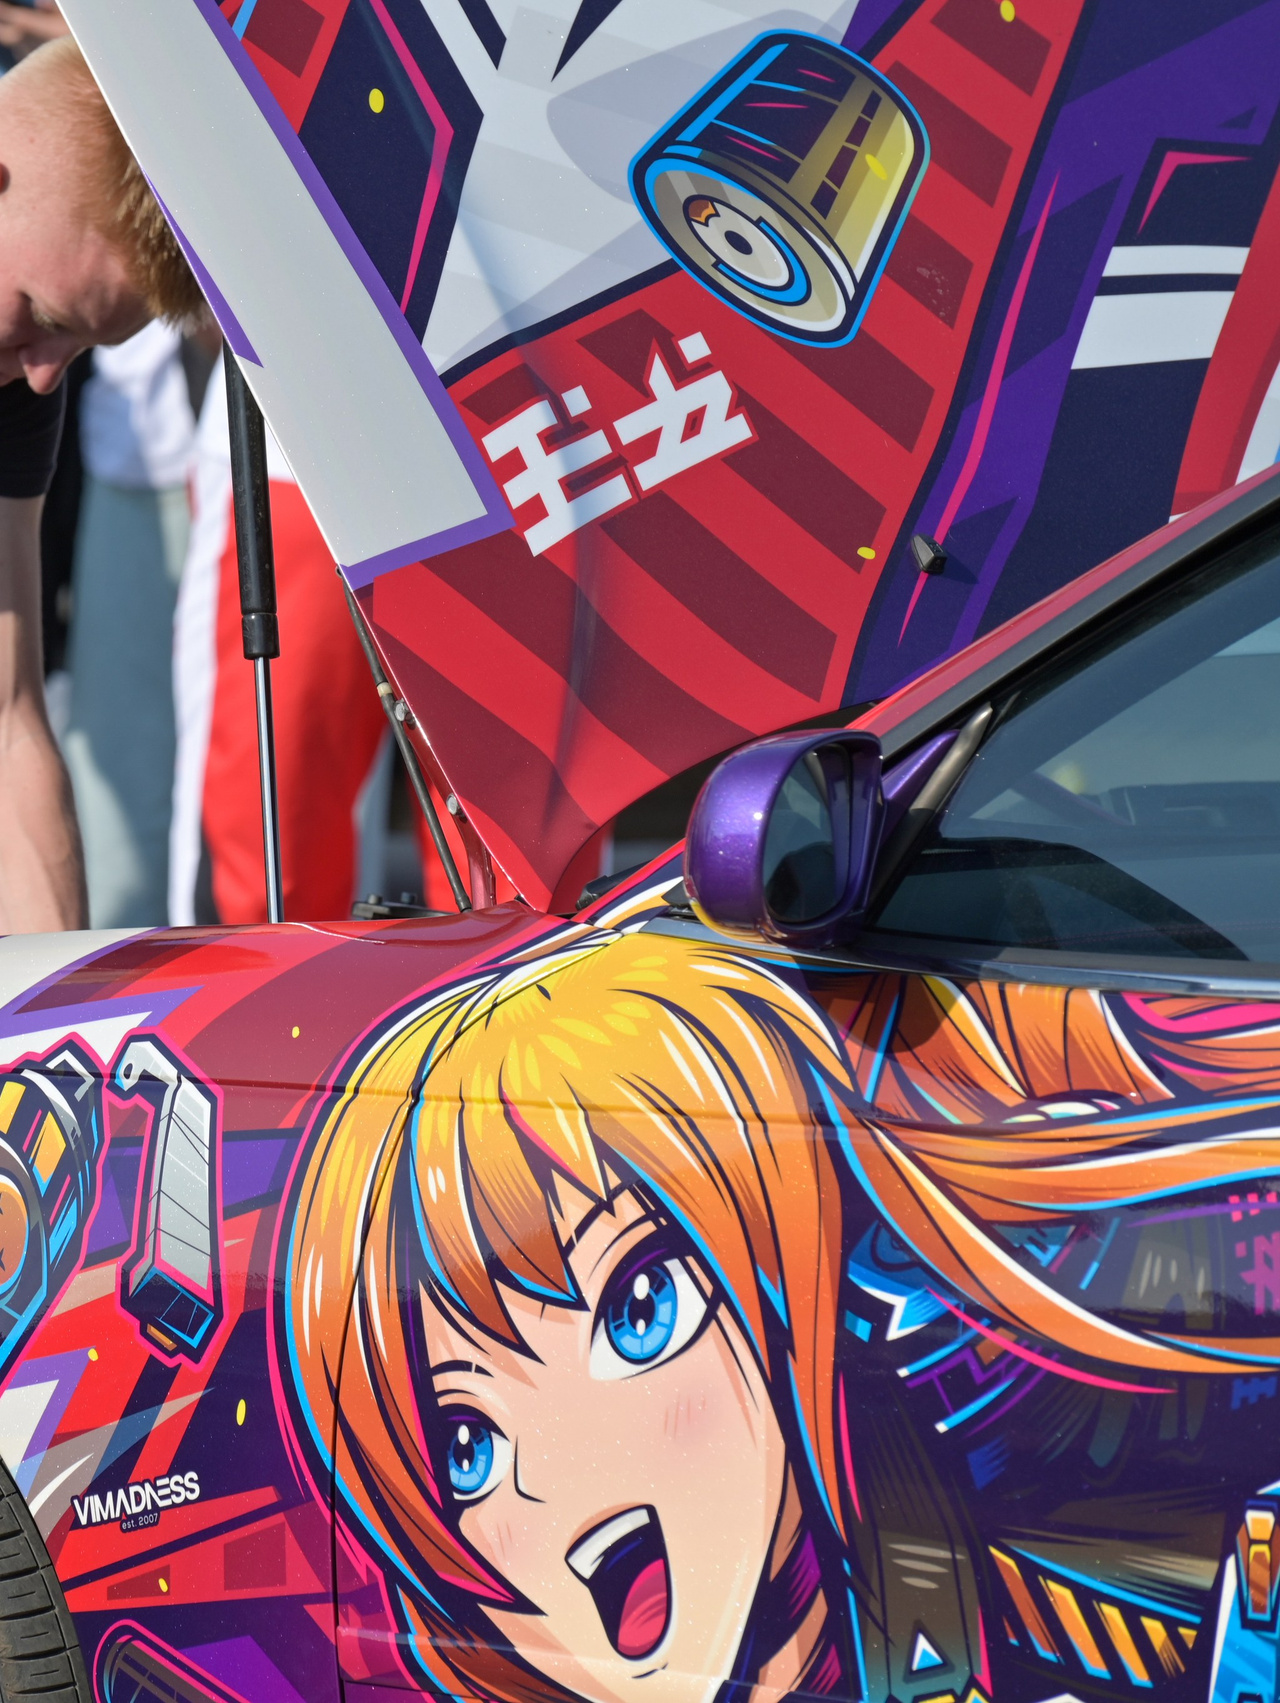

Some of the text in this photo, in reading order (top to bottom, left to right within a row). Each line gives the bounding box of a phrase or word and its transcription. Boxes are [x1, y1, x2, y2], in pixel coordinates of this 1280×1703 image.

[73, 1471, 200, 1526] VIMADNESS
[122, 1513, 159, 1530] est. 2007
